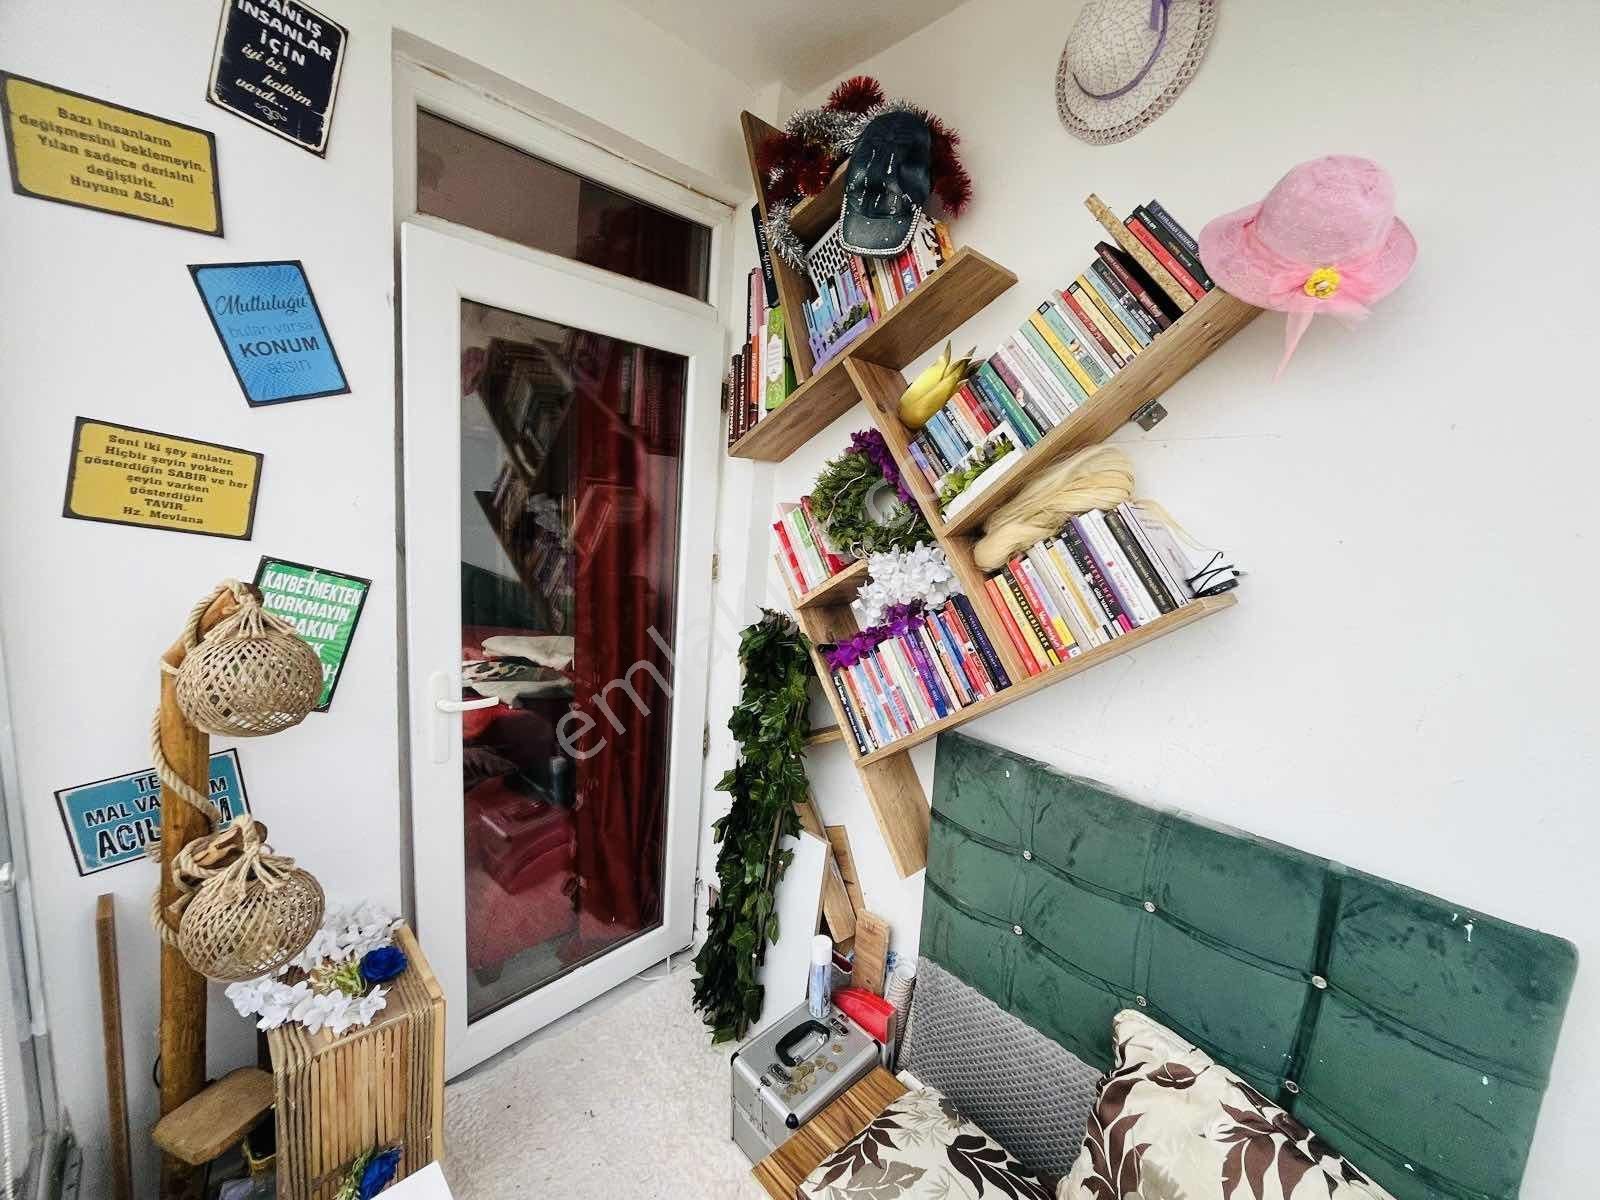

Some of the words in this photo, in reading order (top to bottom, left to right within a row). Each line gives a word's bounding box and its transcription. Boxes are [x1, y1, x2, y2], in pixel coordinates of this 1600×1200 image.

[260, 0, 322, 38] ANLIŞ
[241, 44, 265, 61] iyi
[265, 56, 288, 75] bir
[261, 74, 313, 107] kalbim
[58, 107, 92, 126] Bazı
[97, 118, 172, 148] insanların
[19, 115, 116, 148] değişmesini
[121, 141, 206, 172] beklemeyin.
[38, 134, 79, 155] Yılan
[84, 149, 137, 170] sadece
[142, 164, 194, 184] derisini
[70, 175, 128, 198] Huyunu
[134, 190, 175, 208] ASLA!
[238, 336, 320, 357] KONUM
[104, 446, 147, 462] Hiçbir
[151, 455, 187, 468] şeyin
[191, 461, 234, 476] yokken
[108, 434, 139, 447] Seni
[144, 440, 161, 452] iki
[165, 446, 187, 460] şey
[83, 455, 163, 475] gösterdiğin
[167, 468, 207, 482] SABIR
[211, 476, 225, 486] ve
[228, 479, 248, 489] her
[126, 474, 163, 488] şeyin
[166, 480, 210, 494] varken
[129, 486, 204, 504] gösterdiğin
[150, 510, 204, 525] Mevlana
[262, 570, 363, 606] KAYBETMEKTEN
[263, 591, 350, 622] KORKMAYIN
[84, 803, 132, 827] MAL
